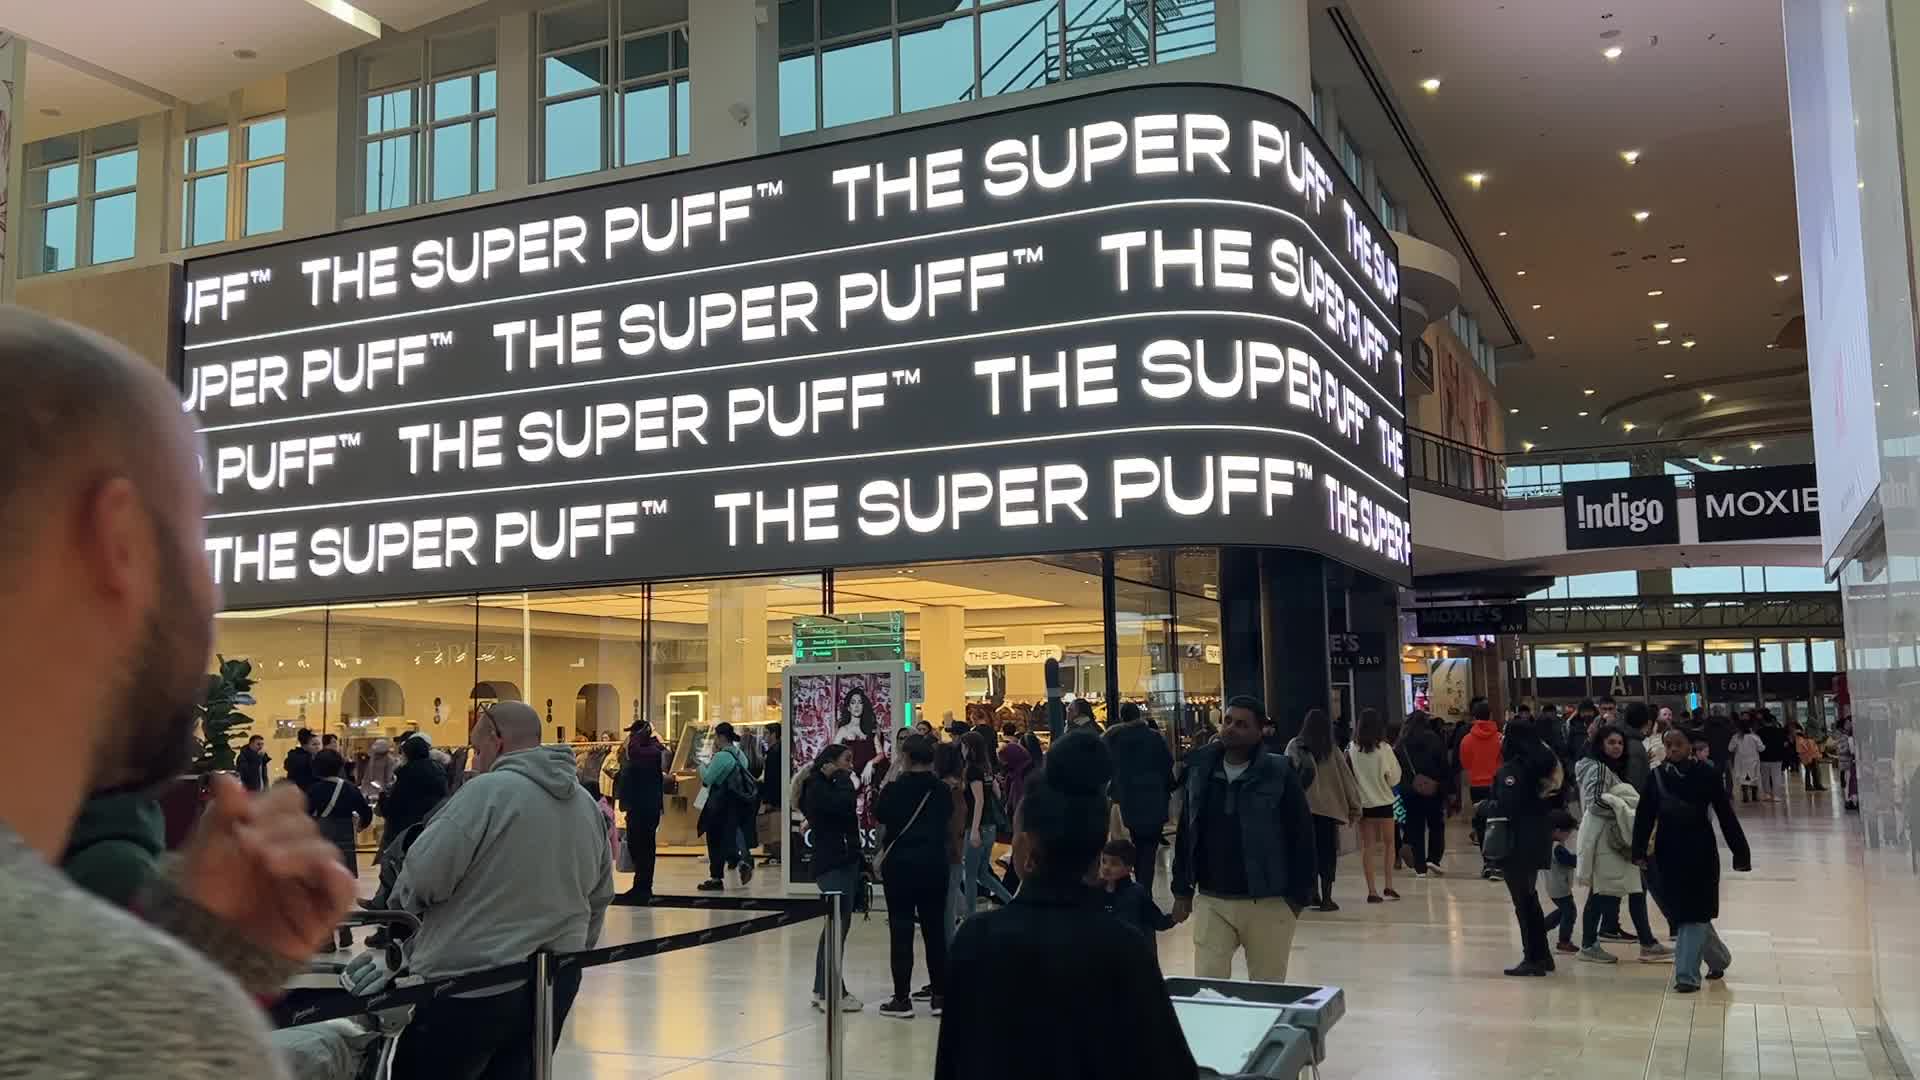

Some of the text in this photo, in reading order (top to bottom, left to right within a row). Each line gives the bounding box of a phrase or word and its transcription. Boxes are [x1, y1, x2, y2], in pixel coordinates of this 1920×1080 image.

[832, 148, 964, 222] THE
[983, 113, 1231, 197] SUPER
[301, 246, 398, 306] THE
[410, 215, 588, 289] SUPER
[1100, 228, 1253, 292] THE
[1270, 238, 1347, 342] SUPER
[1343, 198, 1399, 304] THE SUP
[493, 309, 603, 372] THE
[618, 280, 819, 356] SUPER
[974, 344, 1118, 416] THE
[1140, 339, 1323, 418] SUPER
[398, 415, 504, 475] THE
[517, 393, 709, 463] SUPER
[1377, 415, 1405, 479] THE
[714, 484, 839, 547] THE
[857, 463, 1089, 538] SUPER
[1324, 473, 1360, 542] THE
[1359, 495, 1405, 564] SUPER
[1706, 487, 1818, 518] MOXIE
[203, 530, 298, 585] THE
[308, 516, 479, 577] SUPER
[968, 651, 988, 661] THE
[990, 650, 1023, 660] SUPER
